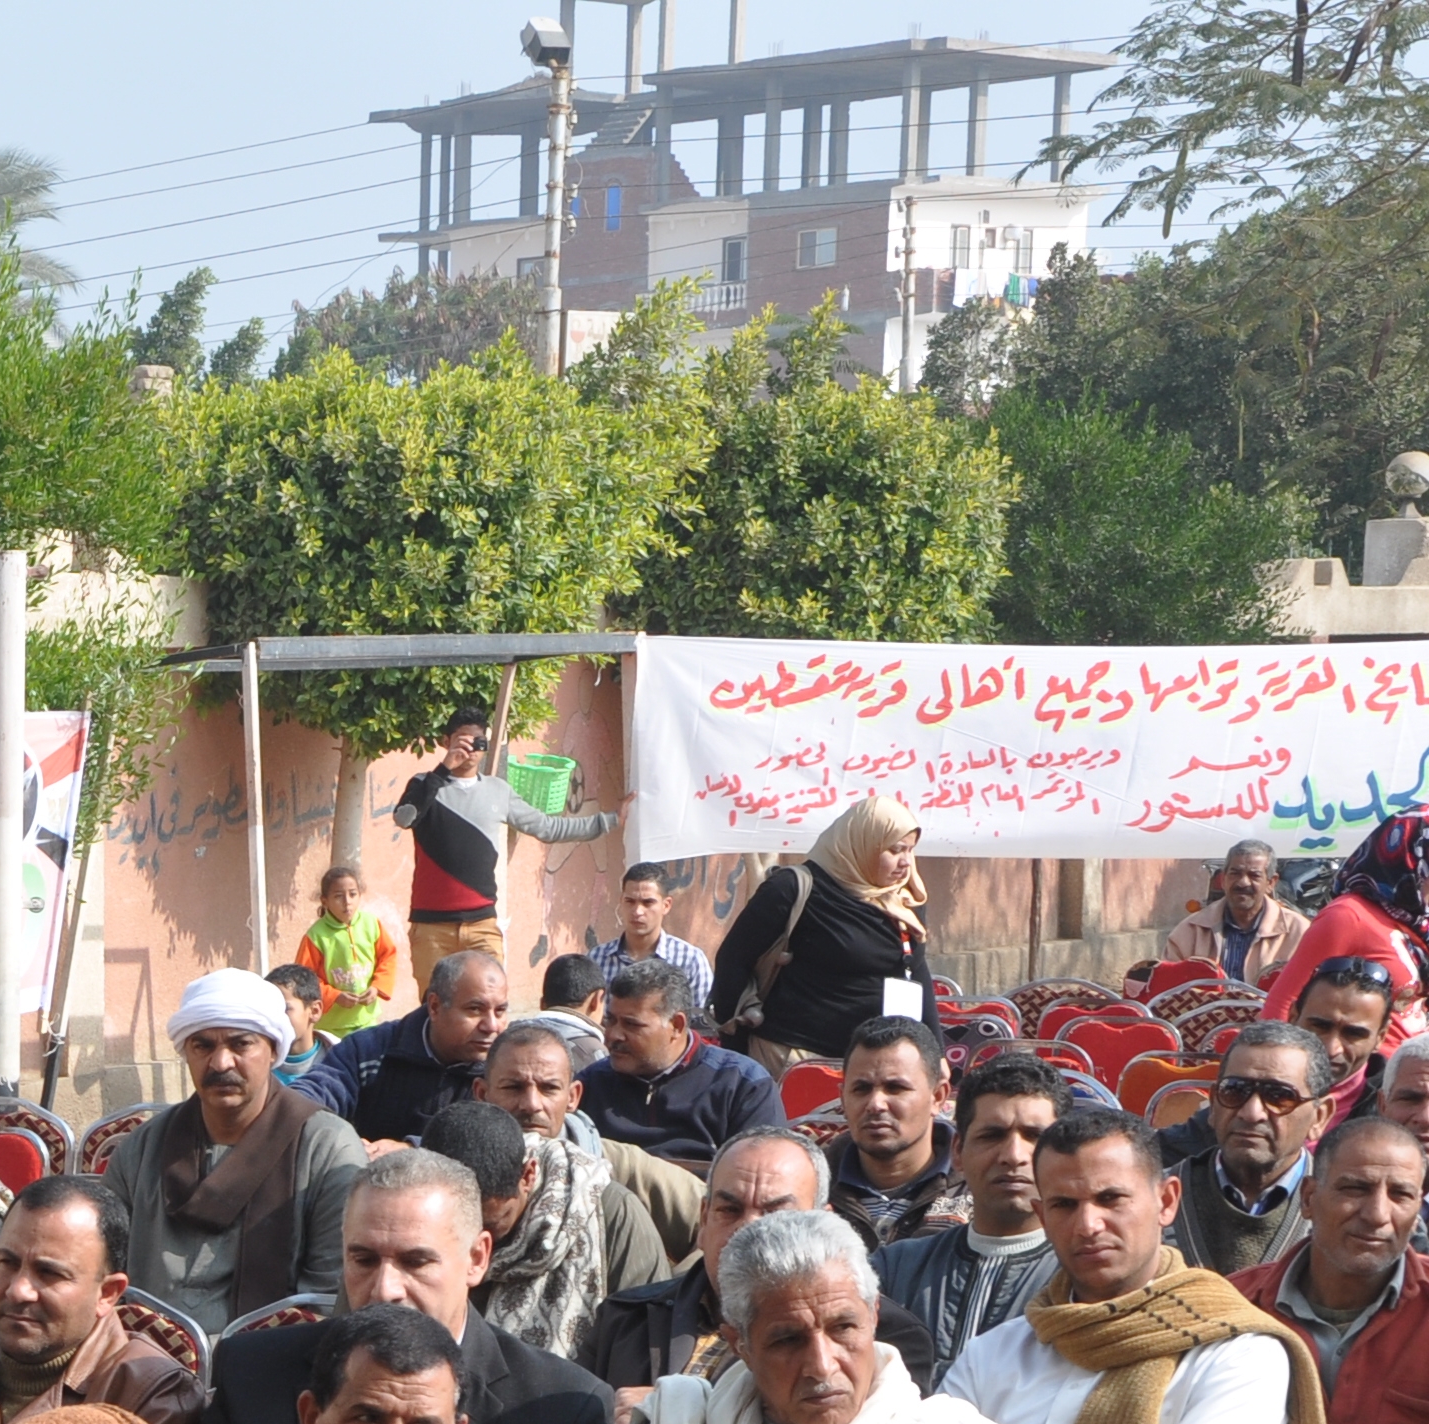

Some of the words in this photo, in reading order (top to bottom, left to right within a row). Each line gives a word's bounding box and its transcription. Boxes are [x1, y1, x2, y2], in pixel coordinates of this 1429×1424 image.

[1035, 661, 1134, 733] وجميع
[1139, 657, 1260, 725] وتوابعها
[1257, 655, 1355, 713] القرية
[981, 783, 1025, 812] العام
[1125, 775, 1269, 833] للدستور
